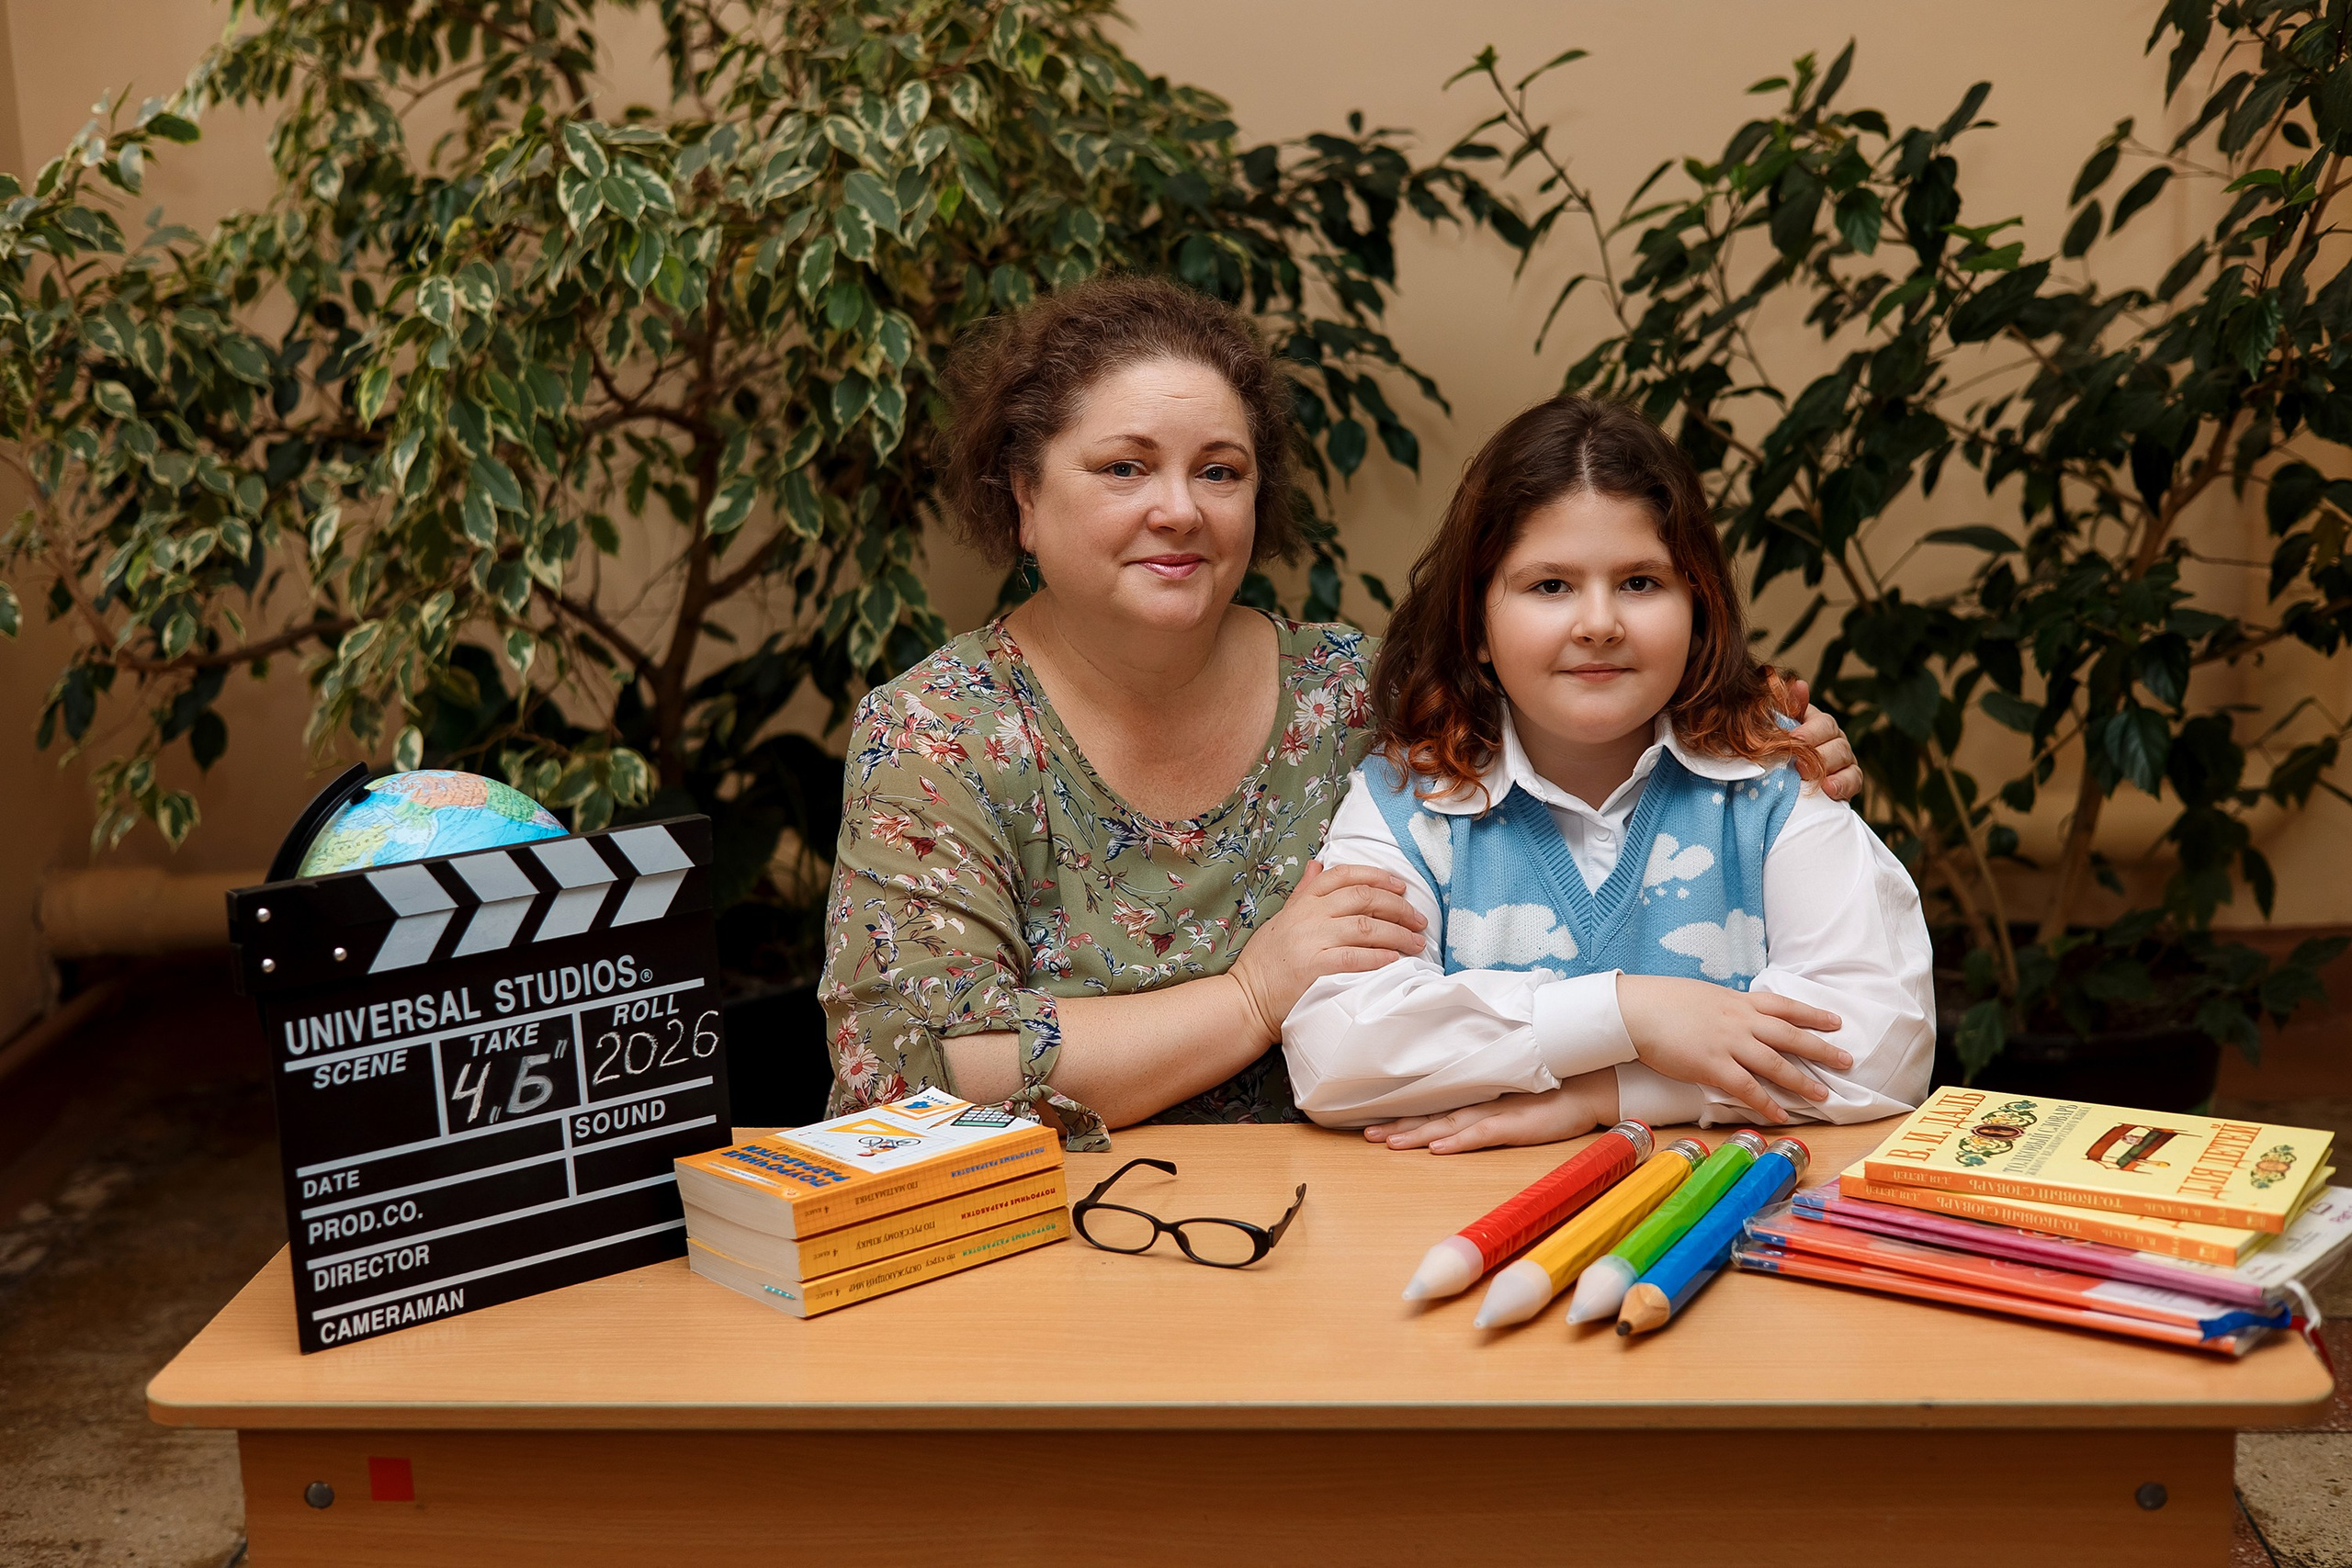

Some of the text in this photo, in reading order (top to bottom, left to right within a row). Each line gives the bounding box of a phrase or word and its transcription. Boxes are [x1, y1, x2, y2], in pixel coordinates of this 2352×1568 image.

[285, 987, 481, 1055] UNIVERSAL
[612, 994, 680, 1027] ROLL
[469, 1022, 540, 1056] TAKE
[593, 1010, 719, 1086] 2026
[313, 1049, 409, 1089] SCENE
[574, 1099, 666, 1139] SOUND
[1885, 1093, 1986, 1162] В. И. ДАЛЬ
[2002, 1105, 2078, 1172] ТОЛКОВЫЙ СЛОВАРЬ
[741, 1145, 852, 1182] РАЗРАБОТКИ
[1000, 1146, 1046, 1166] ПОУРОЧНЫЕ
[2177, 1122, 2263, 1201] ДЛЯ ДЕТЕЙ
[720, 1150, 831, 1188] ПОУРОЧНЫЕ
[951, 1159, 999, 1179] РАЗРАБОТКИ
[1893, 1170, 1928, 1183] ДЕТЕЙ
[1929, 1175, 1952, 1185] ДЛЯ
[302, 1169, 360, 1199] DATE
[854, 1184, 907, 1206] МАТЕМАТИКЕ
[906, 1180, 919, 1191] ПО
[1865, 1185, 1899, 1198] ДЕТЕЙ
[1969, 1179, 2035, 1197] СЛОВАРЬ
[1010, 1187, 1057, 1207] ПОУРОЧНЫЕ
[1898, 1191, 1921, 1202] ДЛЯ
[1936, 1196, 1999, 1216] СЛОВАРЬ
[2038, 1187, 2123, 1209] ТОЛКОВЫЙ
[821, 1204, 830, 1214] 4
[960, 1201, 1009, 1220] РАЗРАБОТКИ
[308, 1200, 424, 1245] PROD.CO.
[922, 1220, 935, 1231] ПО
[1011, 1223, 1057, 1242] ПОУРОЧНЫЕ
[2002, 1210, 2081, 1234] ТОЛКОВЫЙ
[855, 1235, 882, 1250] ЯЗЫКУ
[882, 1224, 922, 1246] РУССКОМУ
[831, 1247, 838, 1258] 4
[962, 1237, 1010, 1257] РАЗРАБОТКИ
[313, 1244, 430, 1292] DIRECTOR
[866, 1263, 922, 1288] ОКРУЖАЮЩИЙ
[833, 1288, 841, 1298] 4
[848, 1280, 866, 1293] МИР
[320, 1288, 464, 1345] CAMERAMAN
